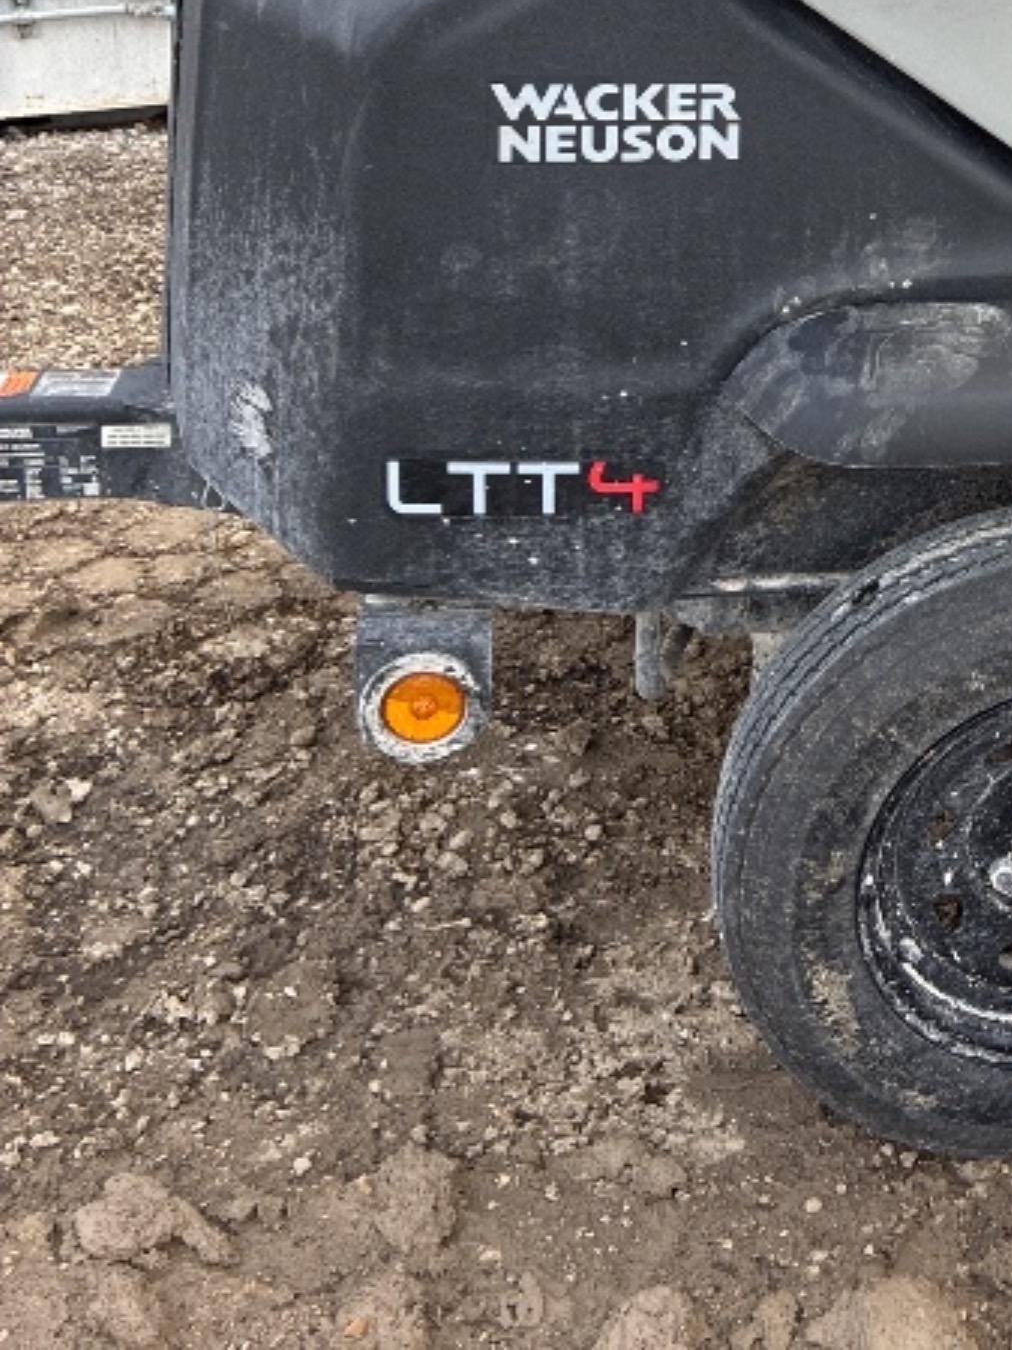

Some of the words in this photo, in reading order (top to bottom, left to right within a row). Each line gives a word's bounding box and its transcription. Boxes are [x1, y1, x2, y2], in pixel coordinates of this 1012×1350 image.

[490, 82, 741, 122] WACKER
[497, 122, 740, 163] NEUSON
[386, 460, 661, 515] LTT4
